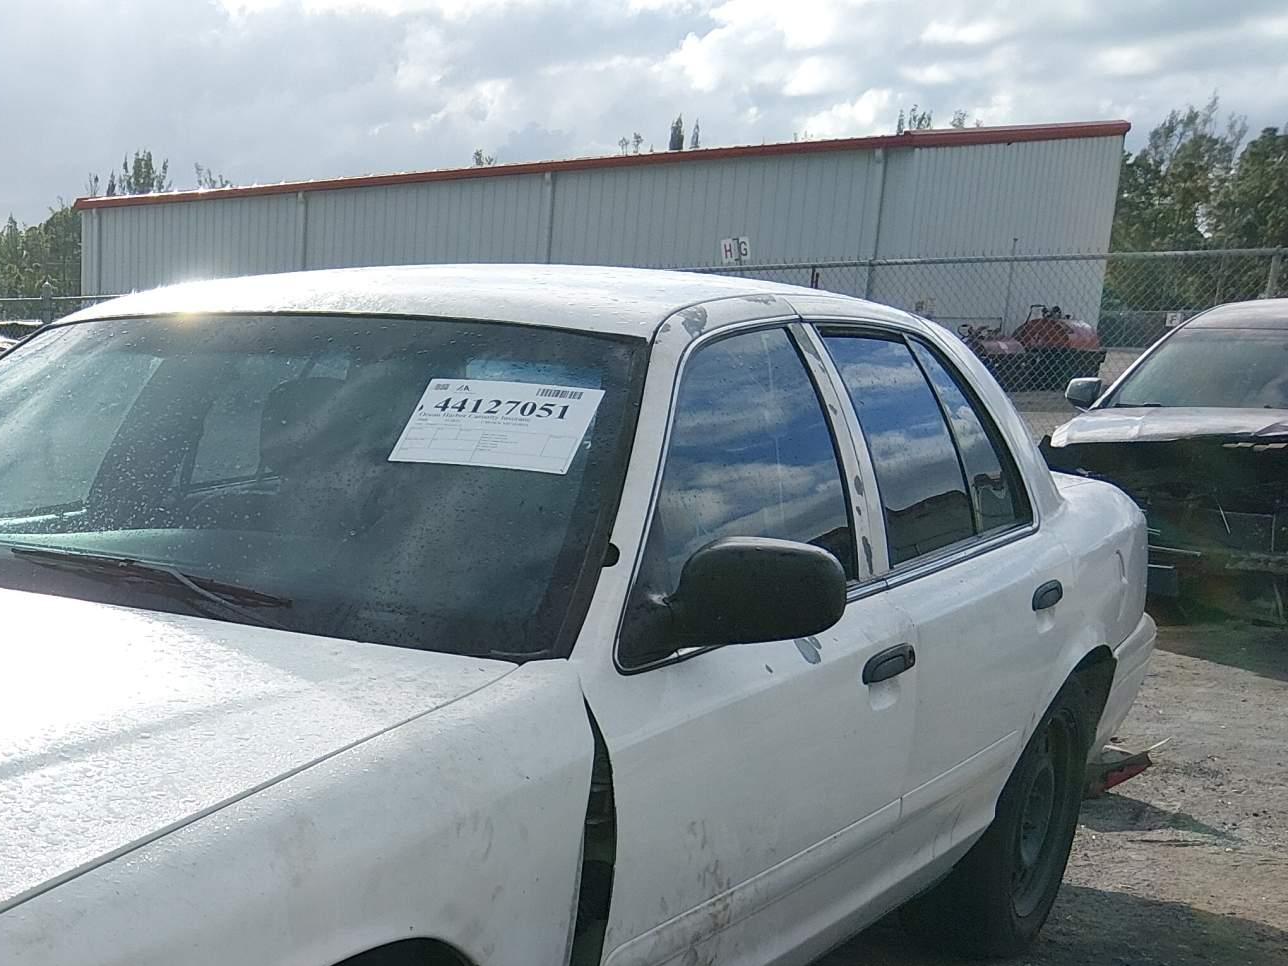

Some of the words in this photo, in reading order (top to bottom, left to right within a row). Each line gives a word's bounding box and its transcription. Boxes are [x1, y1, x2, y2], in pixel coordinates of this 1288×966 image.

[723, 243, 733, 259] H
[739, 240, 748, 257] G
[434, 397, 570, 420] 44127051
